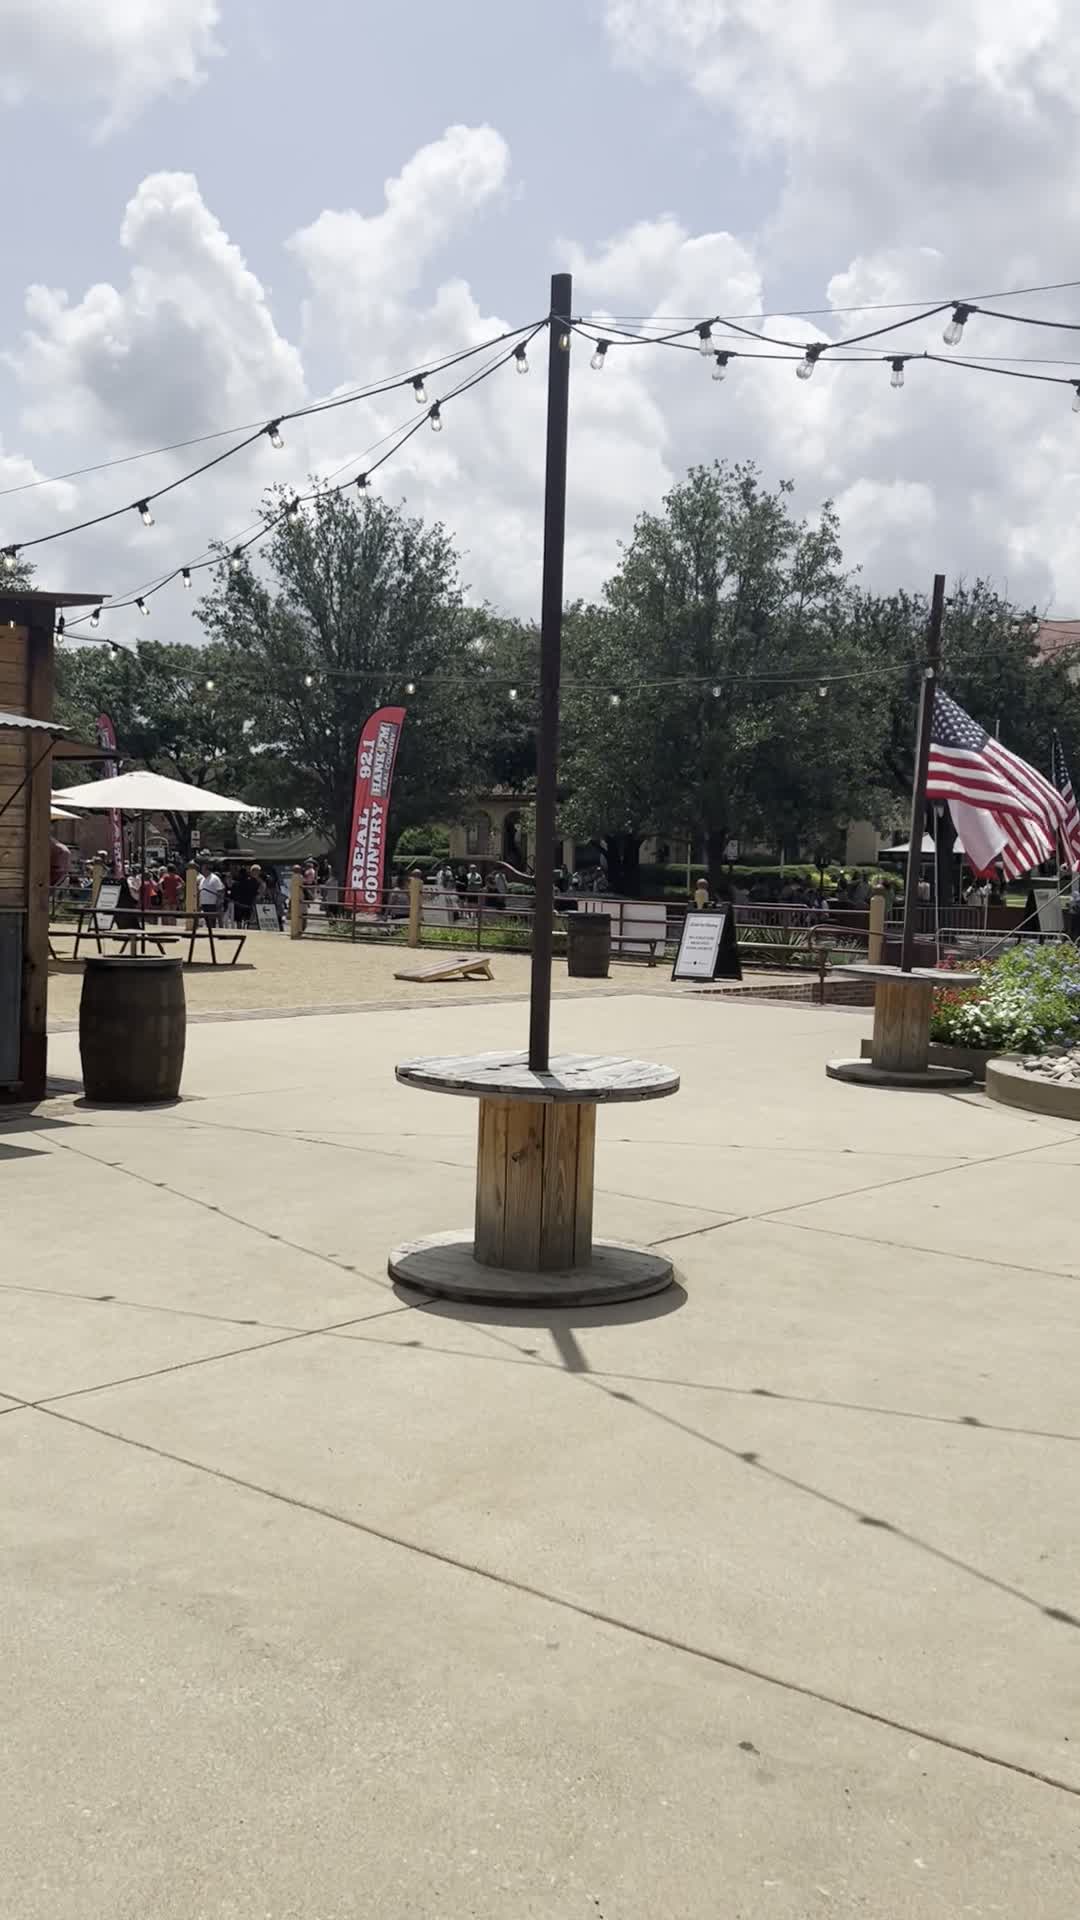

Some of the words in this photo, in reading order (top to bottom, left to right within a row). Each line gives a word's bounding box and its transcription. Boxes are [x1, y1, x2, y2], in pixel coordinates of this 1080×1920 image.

[378, 726, 391, 748] FM
[360, 740, 376, 779] 92.1
[372, 751, 386, 793] HANK
[351, 808, 370, 889] REAL
[365, 801, 383, 903] COUNTRY
